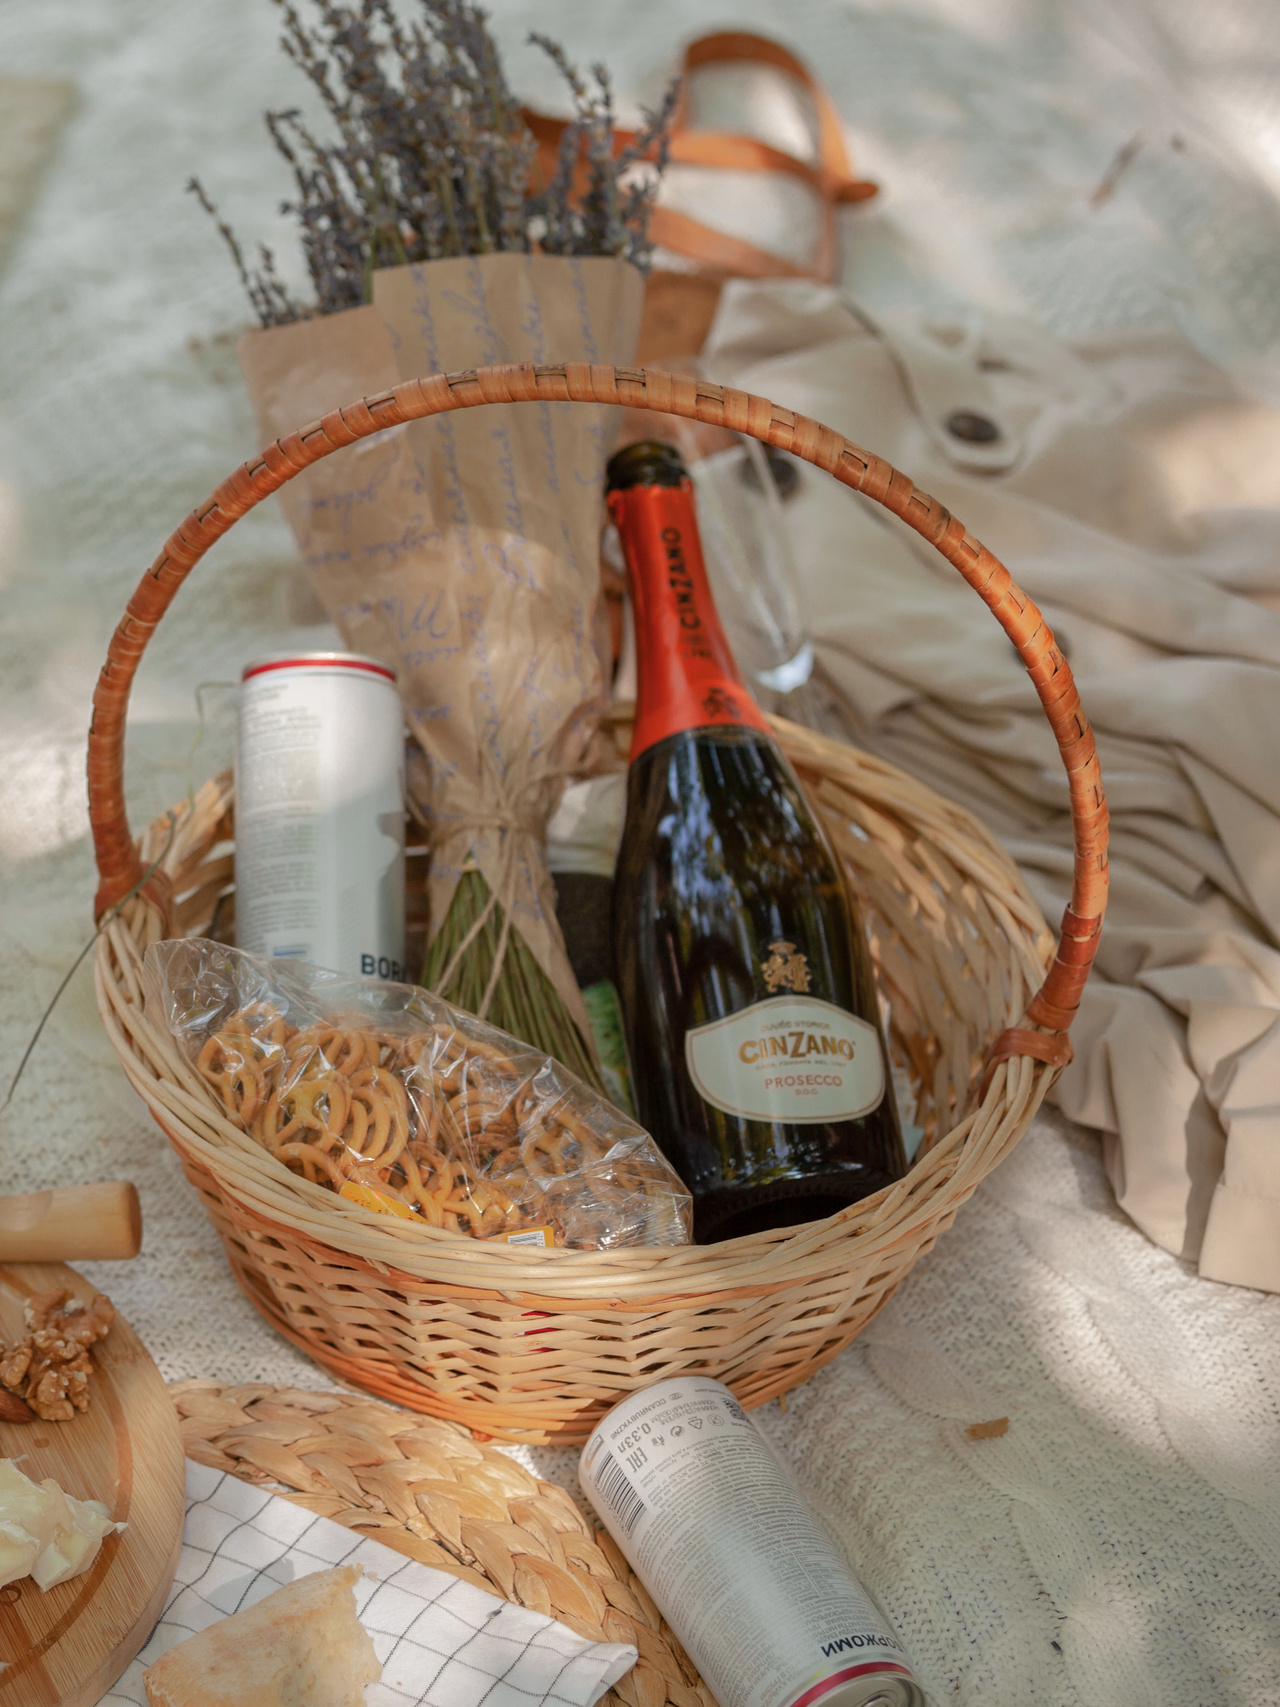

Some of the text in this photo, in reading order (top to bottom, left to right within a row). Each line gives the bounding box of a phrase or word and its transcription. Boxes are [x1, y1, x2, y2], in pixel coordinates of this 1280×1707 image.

[660, 526, 702, 630] CINZANO
[739, 1032, 855, 1064] CINZANO
[764, 1074, 843, 1089] PROSECCO
